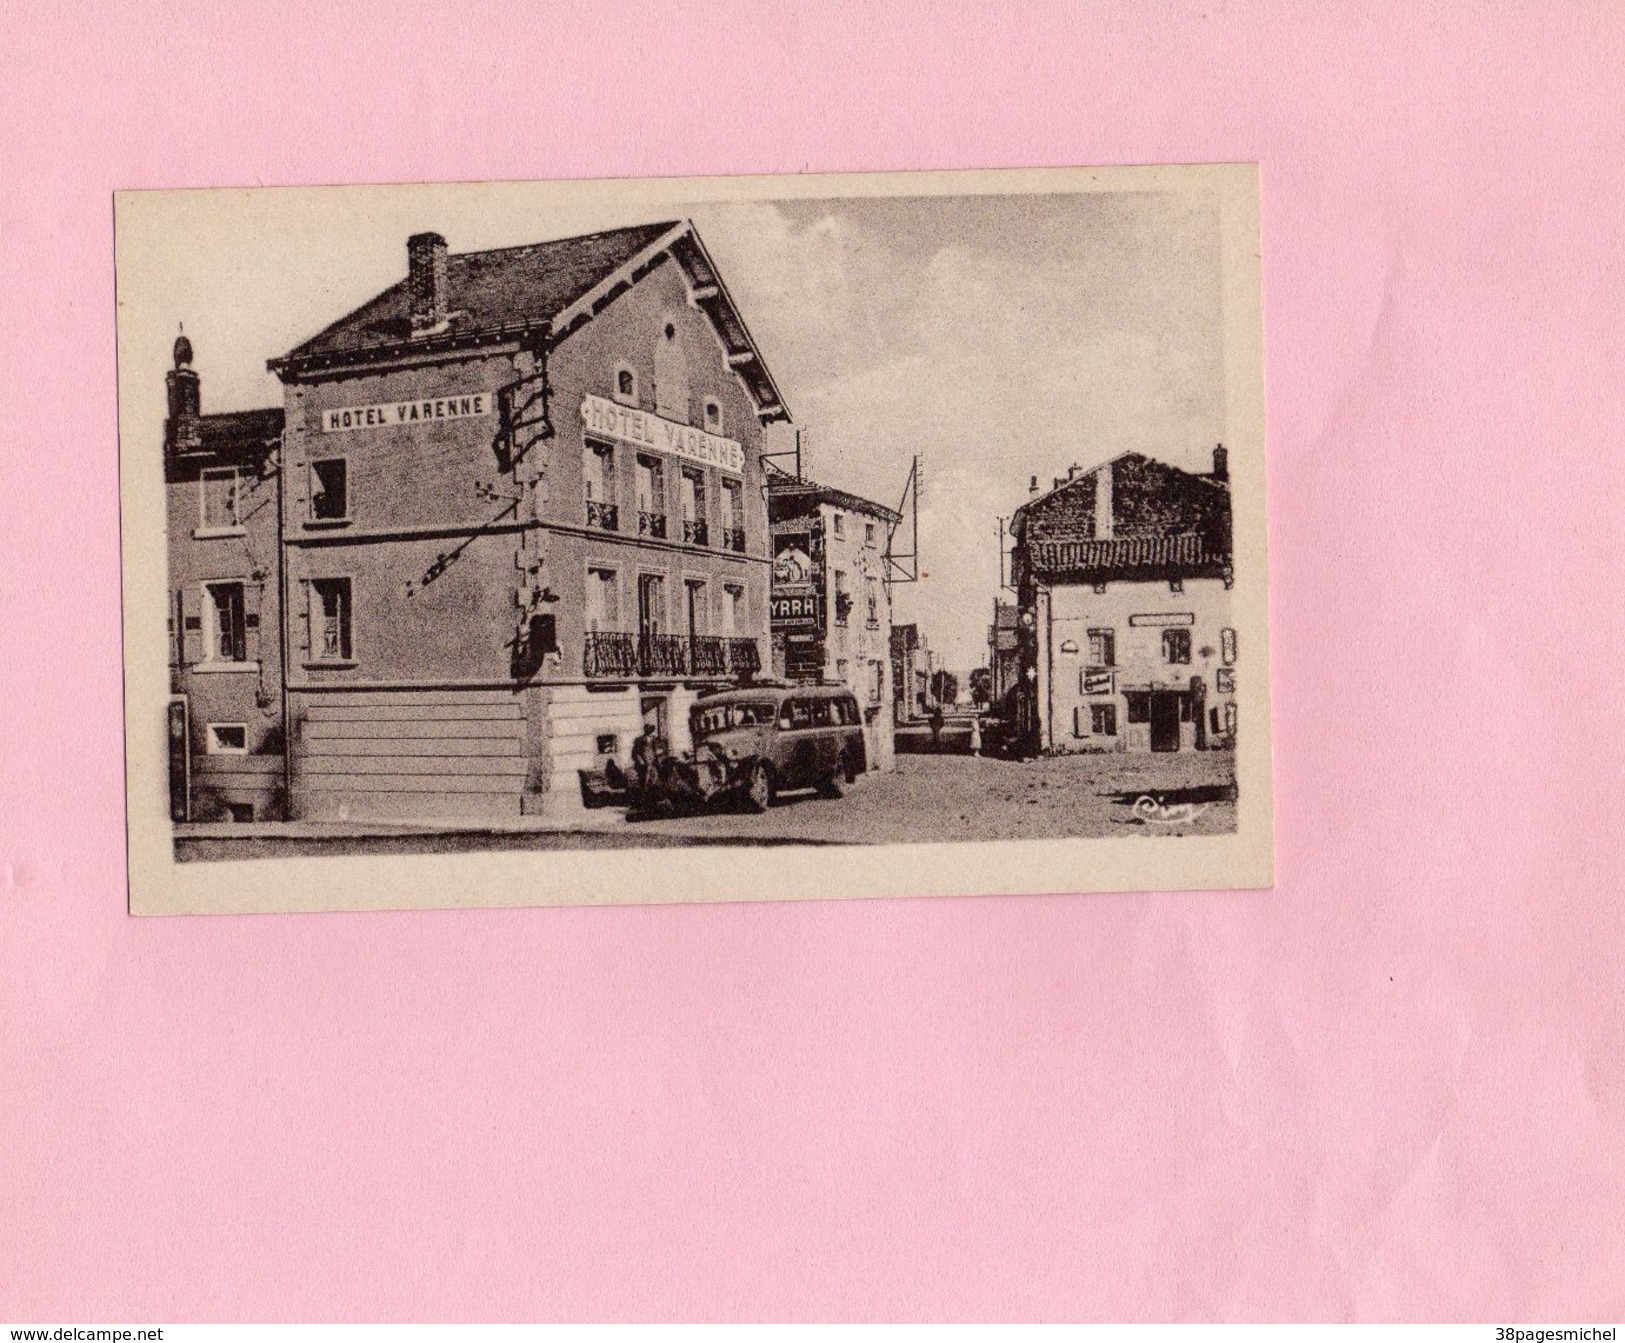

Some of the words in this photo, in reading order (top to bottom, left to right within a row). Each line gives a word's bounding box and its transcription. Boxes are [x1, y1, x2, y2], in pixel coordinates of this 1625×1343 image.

[330, 408, 386, 429] HOTEL
[397, 396, 484, 422] VARENNE
[591, 402, 655, 445] HOTEL
[664, 422, 741, 470] VARENNE
[769, 598, 814, 617] YRRH
